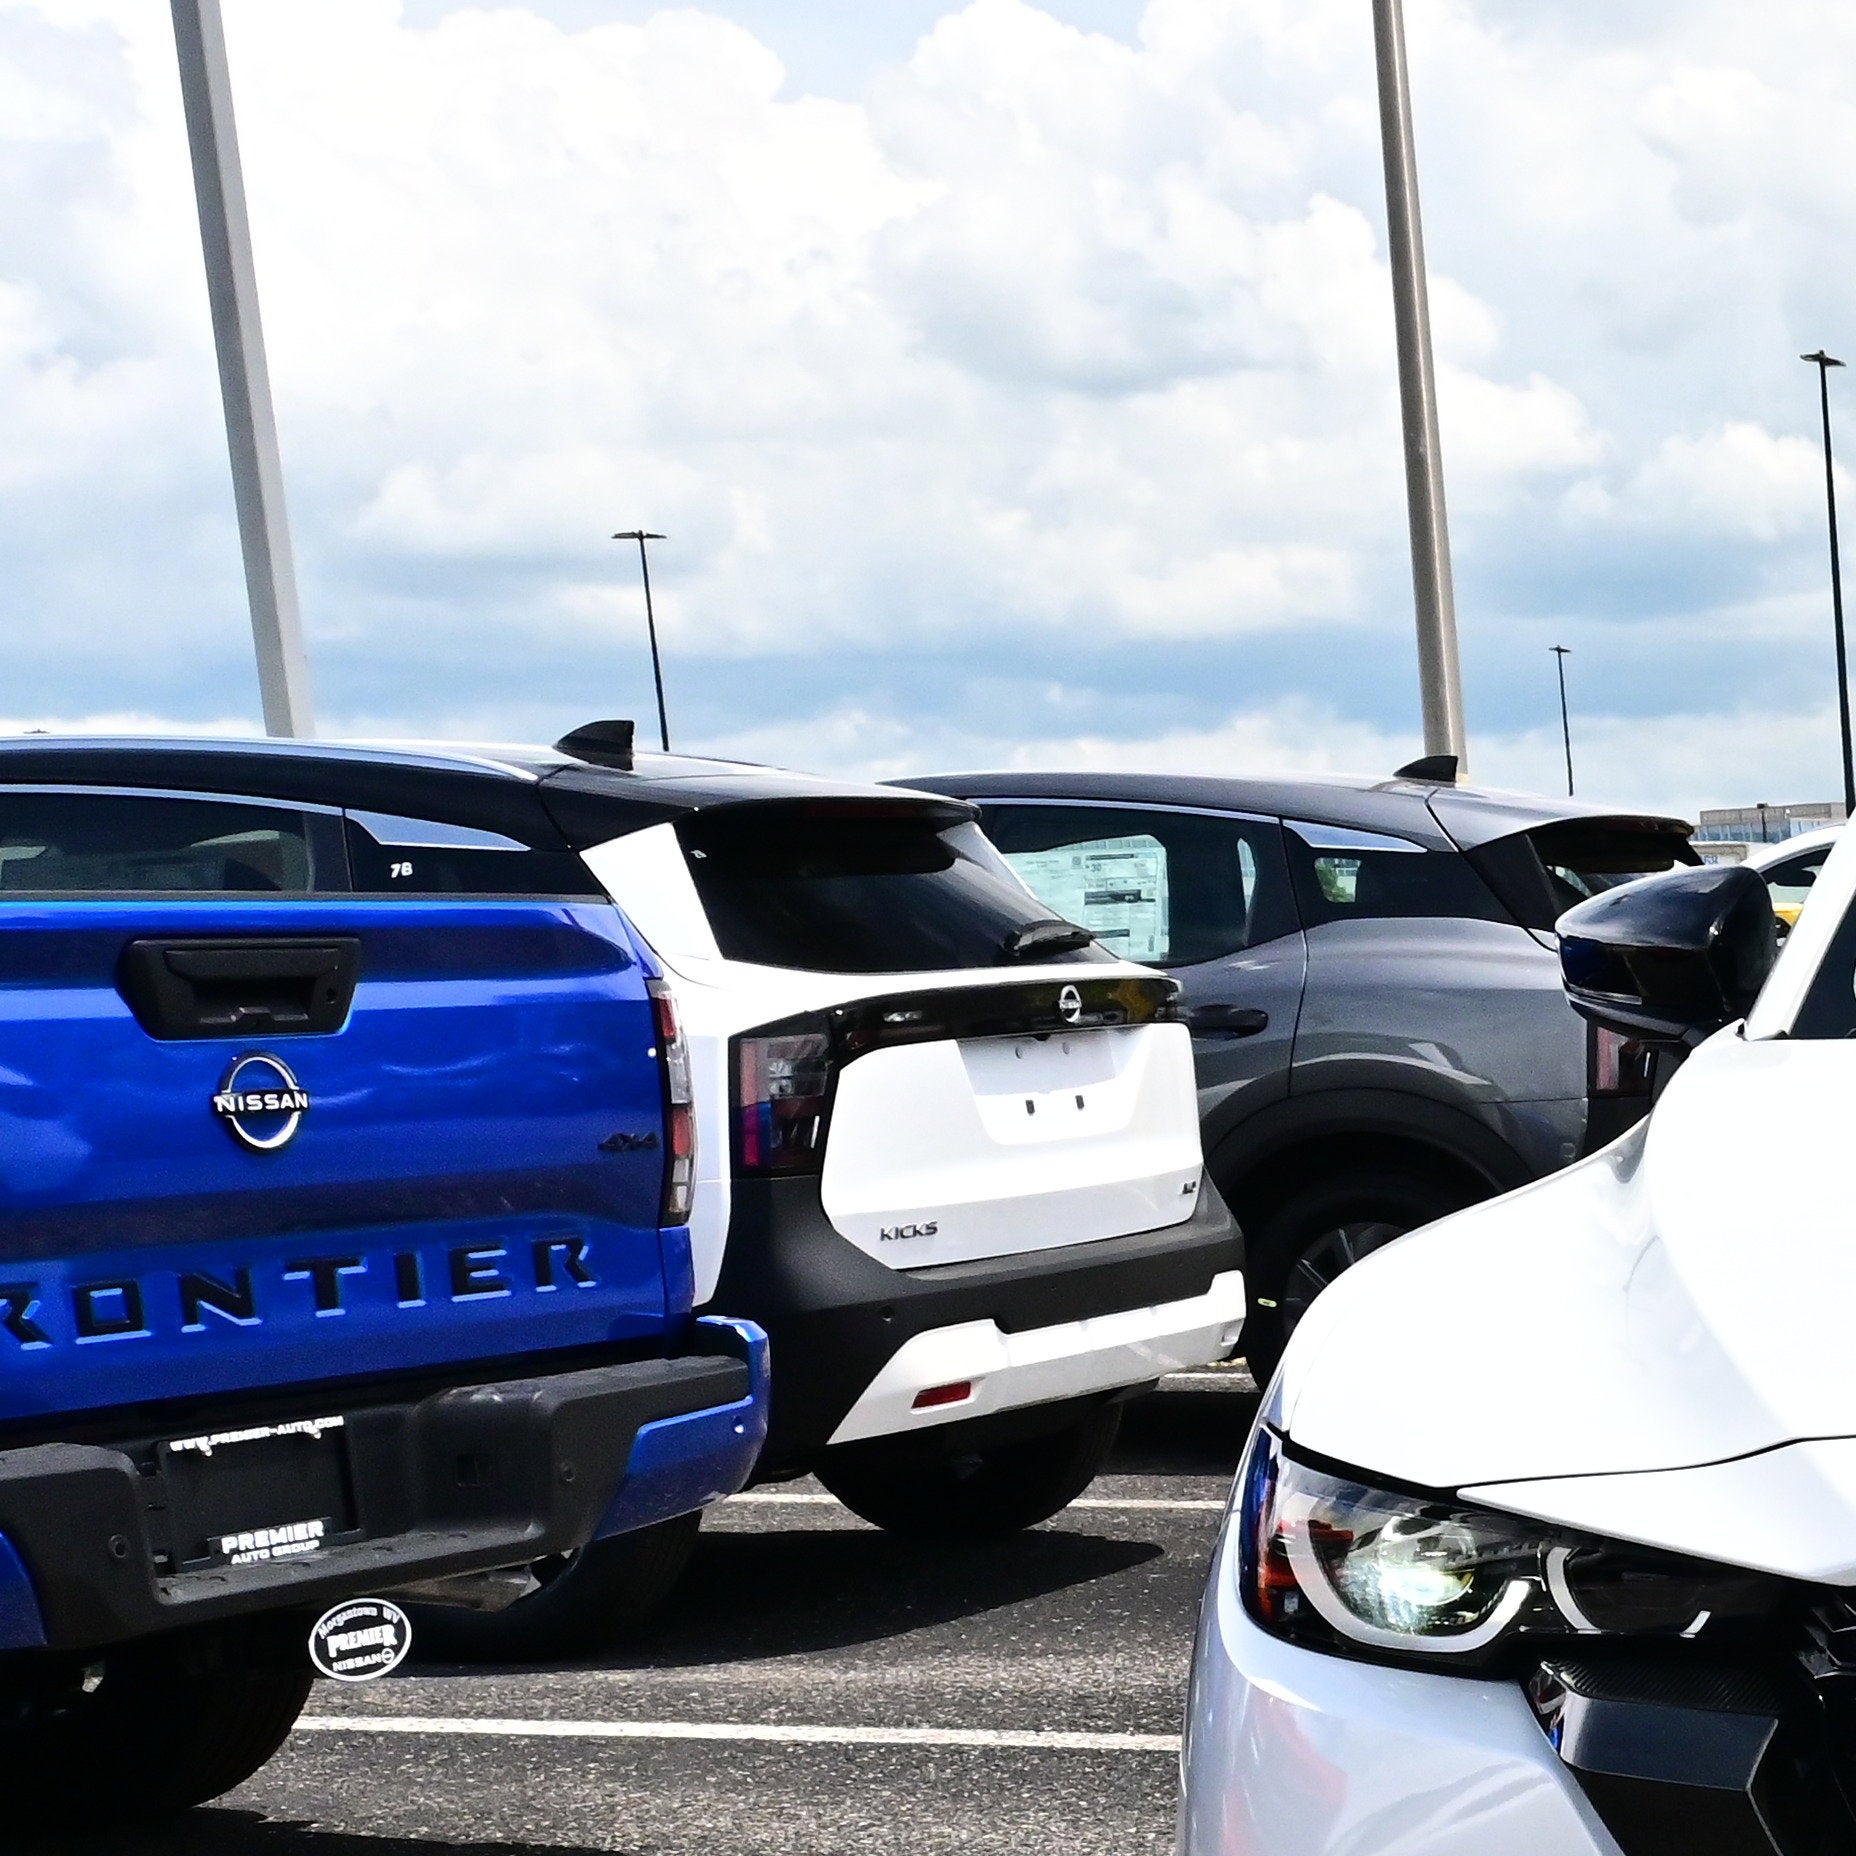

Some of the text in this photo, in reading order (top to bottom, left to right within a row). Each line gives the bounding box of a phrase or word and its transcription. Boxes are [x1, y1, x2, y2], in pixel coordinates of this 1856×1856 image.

[213, 1092, 309, 1113] NISSAN
[880, 1220, 939, 1241] KICKS
[221, 1520, 325, 1554] PREMIER
[230, 1539, 321, 1565] AUTO GROUP
[318, 1606, 401, 1640] Morgantown WV
[326, 1624, 399, 1658] PREMIER
[332, 1652, 383, 1672] NISSAN
